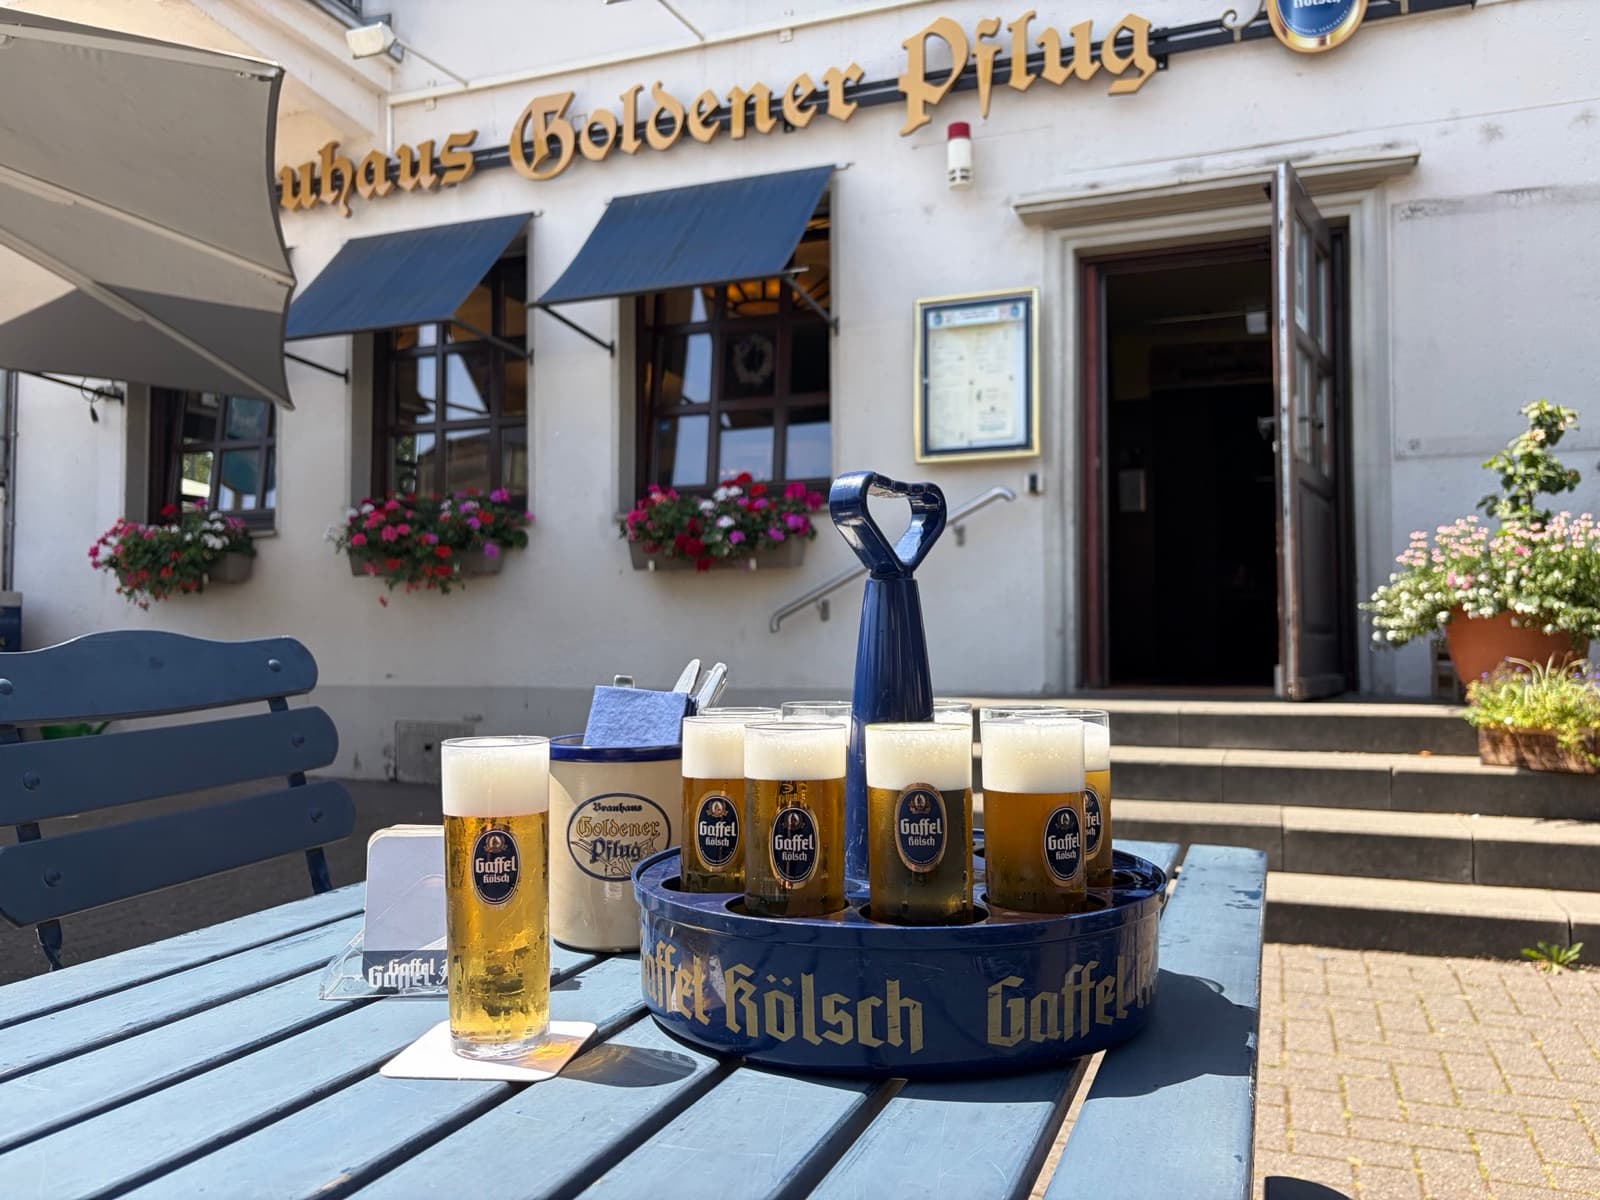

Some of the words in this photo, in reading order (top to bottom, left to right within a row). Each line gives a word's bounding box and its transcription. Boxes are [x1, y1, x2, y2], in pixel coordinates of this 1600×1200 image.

[279, 129, 479, 218] uhaus
[509, 62, 866, 181] Goldener
[898, 10, 1158, 137] Pflug
[575, 815, 660, 838] Goldener
[699, 820, 737, 838] Gaffel
[900, 818, 943, 836] Gaffel
[705, 837, 729, 847] Kölsch
[775, 834, 815, 851] Gaffel
[908, 836, 935, 847] Kölsch
[1047, 832, 1081, 850] Gaffel
[590, 837, 641, 865] Pflug
[781, 850, 808, 862] Kölsch
[475, 856, 518, 874] Gaffel
[483, 873, 510, 884] Kölsch
[389, 958, 436, 977] Gaffel
[641, 940, 710, 1026] affel
[724, 963, 923, 1054] Kölsch
[987, 954, 1130, 1049] Gaffel
